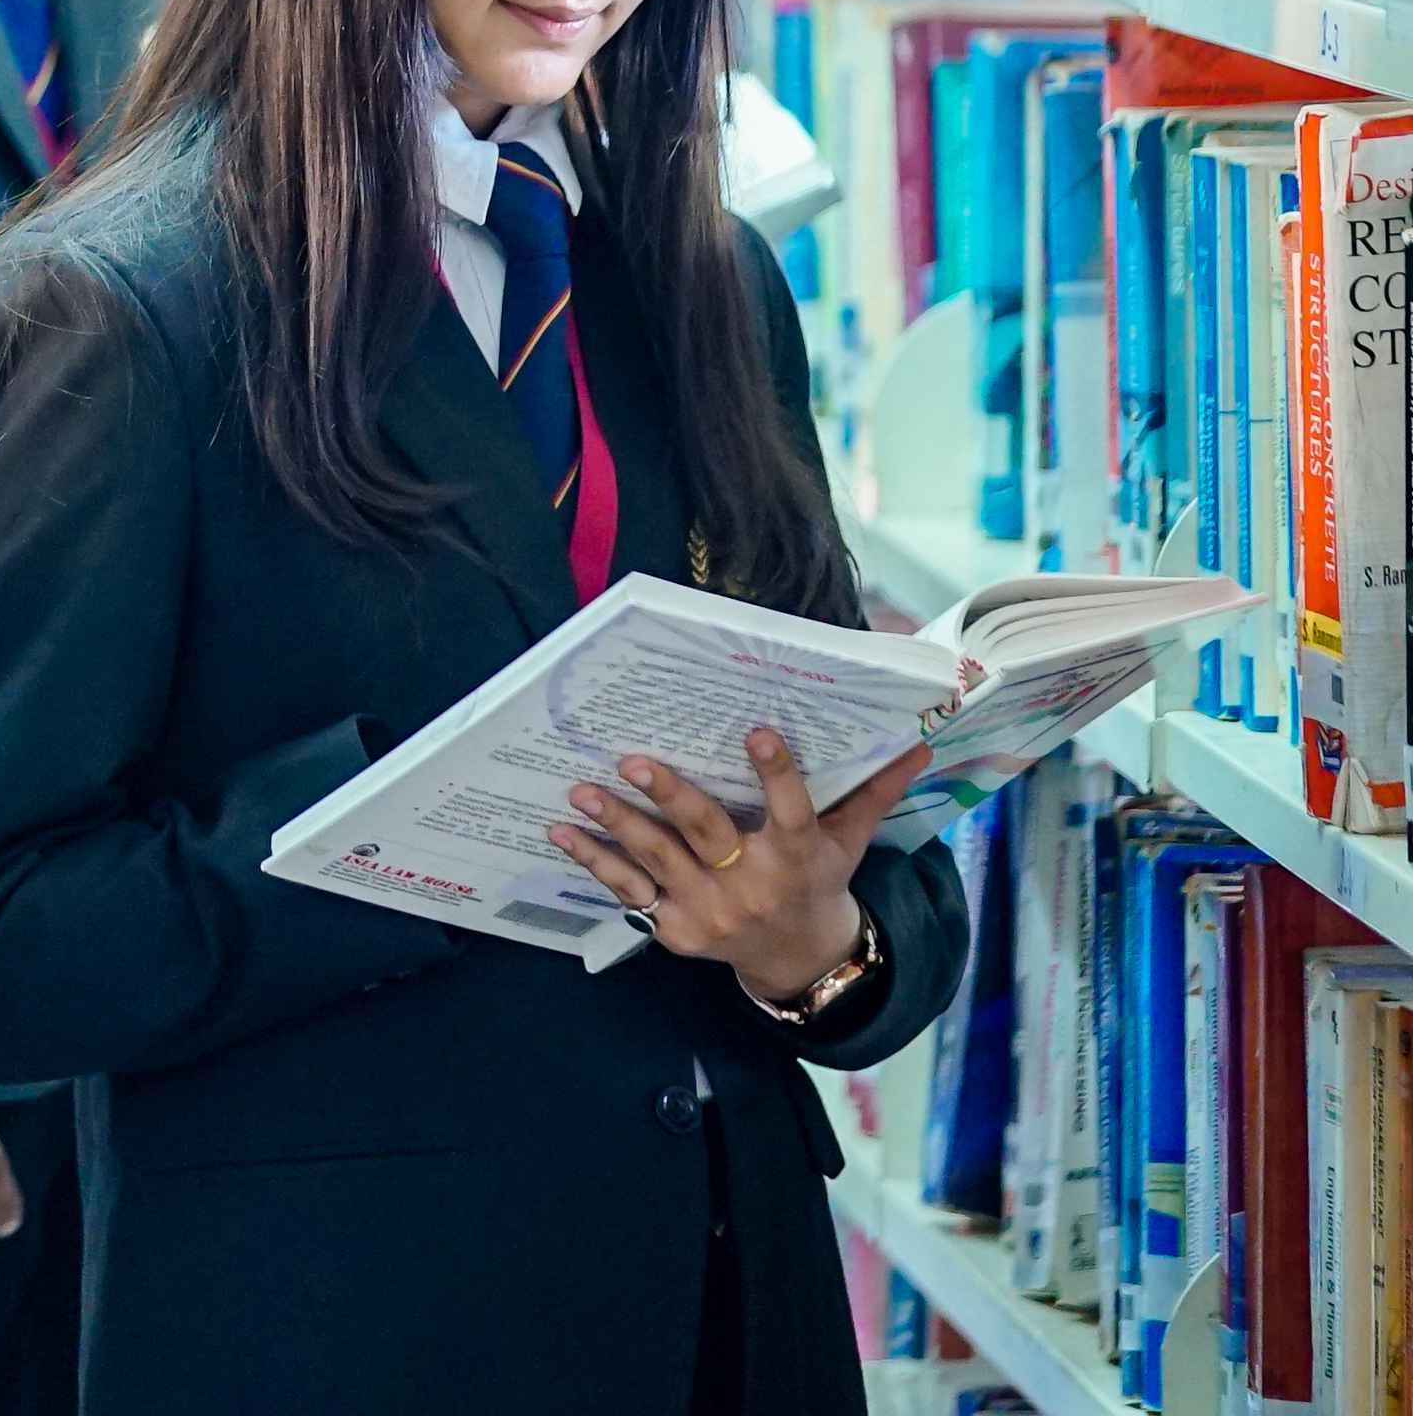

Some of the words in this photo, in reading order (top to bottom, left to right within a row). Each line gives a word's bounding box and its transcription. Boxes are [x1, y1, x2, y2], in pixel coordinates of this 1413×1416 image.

[1171, 153, 1187, 296] Structures
[1346, 216, 1406, 257] RE
[1309, 253, 1323, 477] STRUCTURES
[1352, 327, 1406, 369] ST
[1323, 397, 1336, 583] CONCRETE
[1364, 566, 1378, 588] S.
[341, 854, 378, 870] ASIA
[382, 865, 416, 880] LAW
[422, 875, 478, 895] HOUSE
[1378, 1049, 1386, 1152] EARTHQUAKE
[1325, 1166, 1336, 1271] Engineering
[1378, 1160, 1386, 1239] RESISTANT
[1326, 1279, 1336, 1294] &
[1325, 1302, 1336, 1379] Planning
